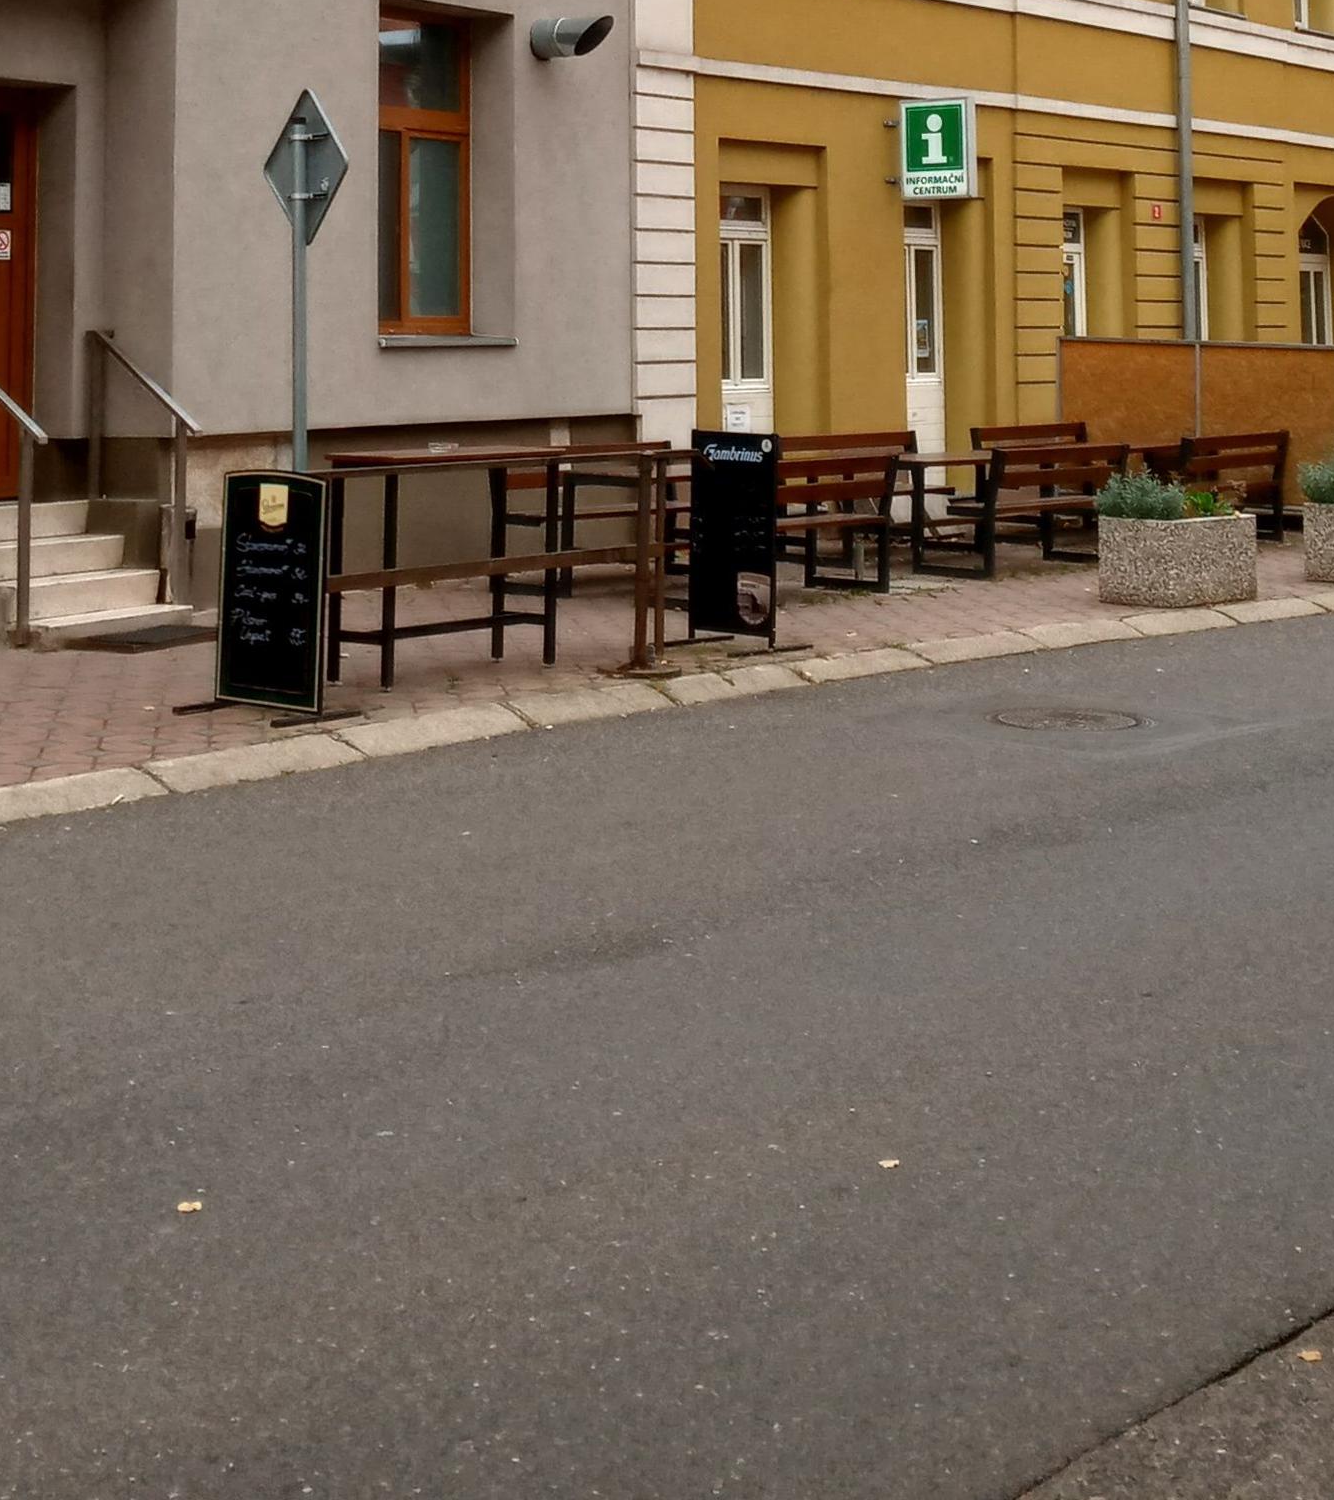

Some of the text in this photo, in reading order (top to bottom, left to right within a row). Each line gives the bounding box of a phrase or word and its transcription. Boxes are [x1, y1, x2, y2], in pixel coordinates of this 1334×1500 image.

[906, 173, 964, 185] INFORMAČNÍ
[913, 186, 957, 195] CENTRUM
[704, 443, 763, 462] Gambrinus
